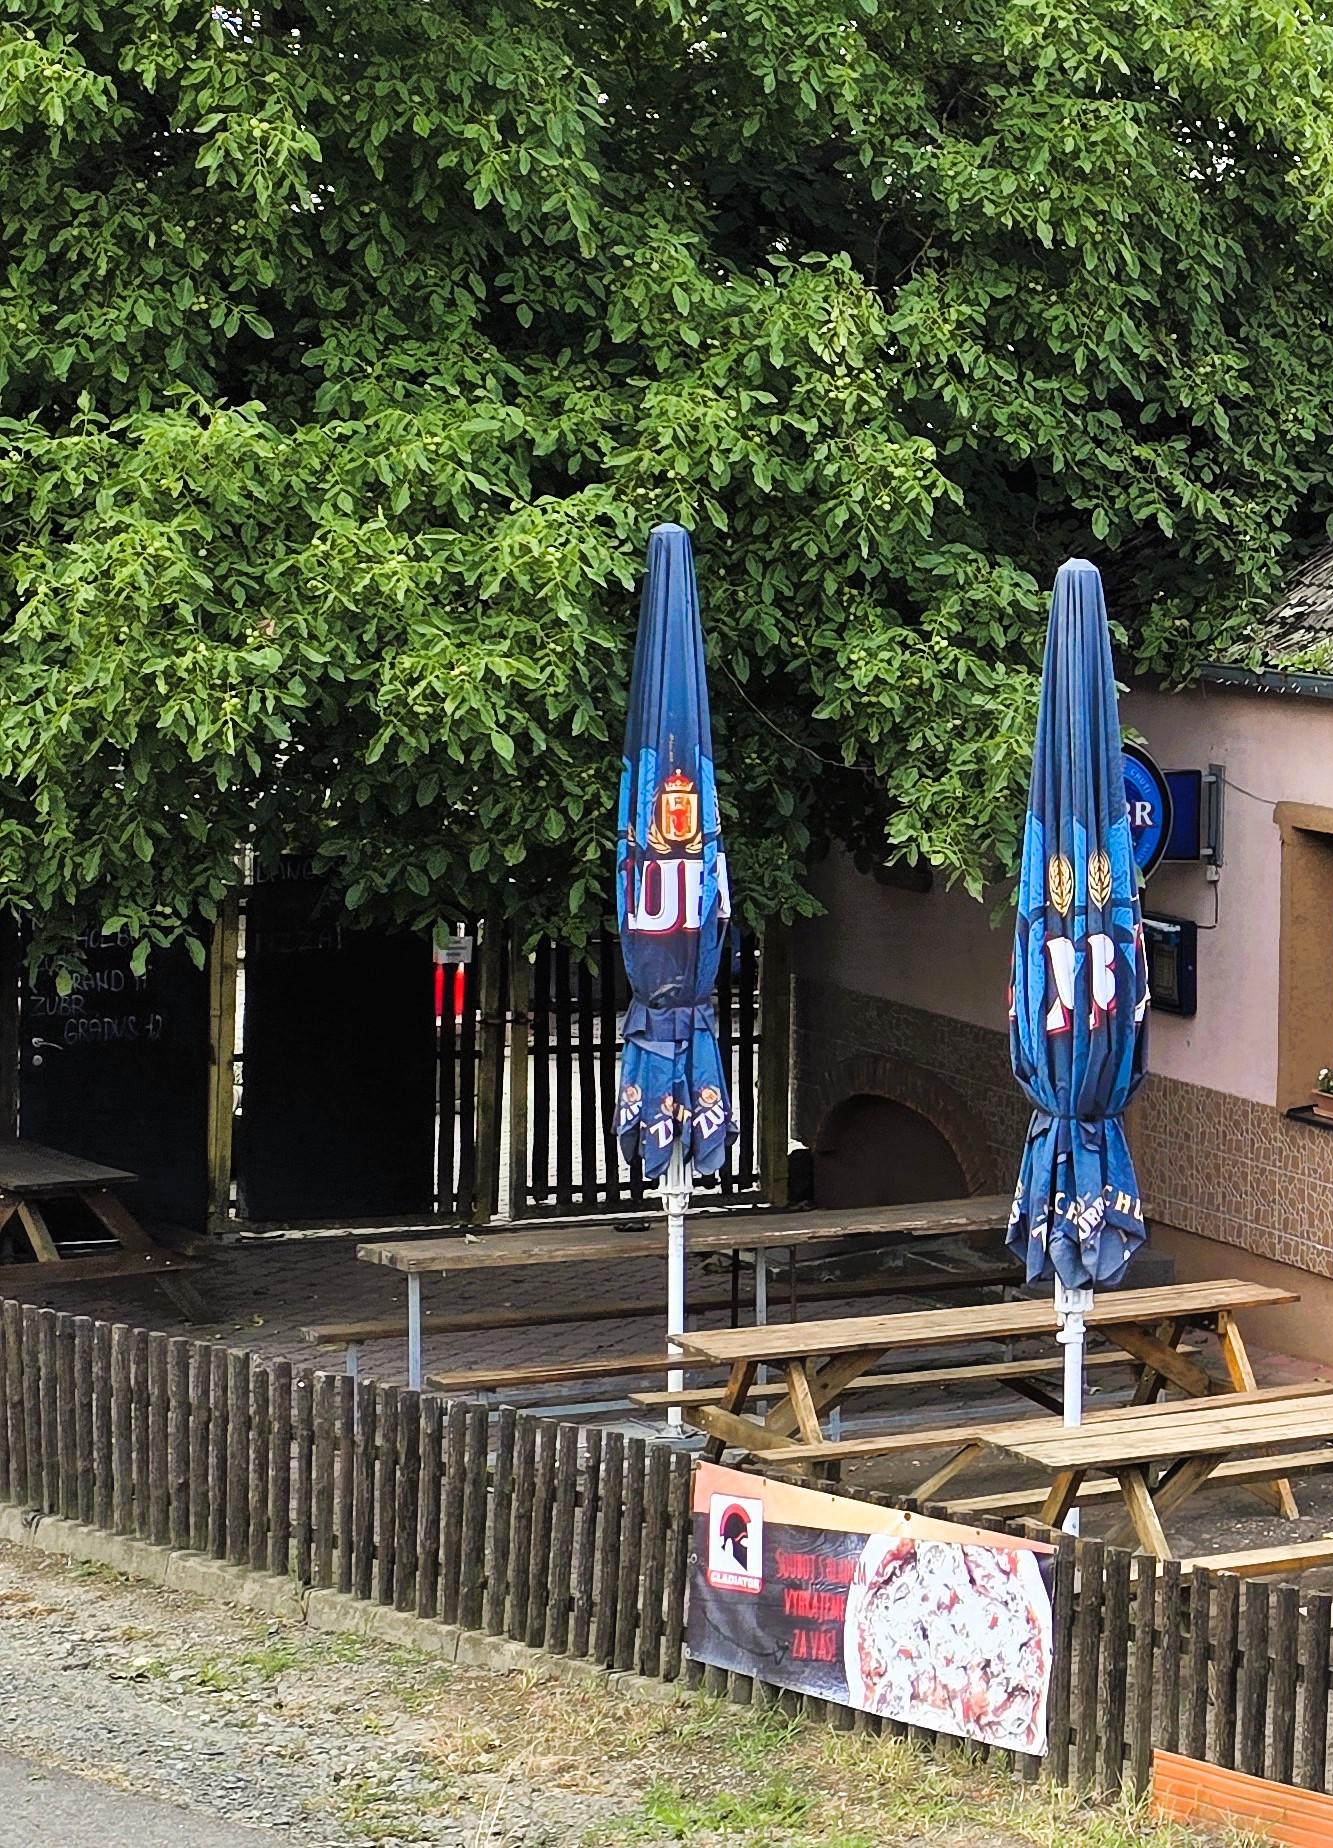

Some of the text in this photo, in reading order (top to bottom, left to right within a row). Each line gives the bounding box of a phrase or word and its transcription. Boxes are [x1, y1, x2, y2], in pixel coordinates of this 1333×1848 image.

[72, 969, 125, 992] RAND
[710, 1570, 761, 1592] GLADIATOR
[792, 1628, 808, 1659] ZA
